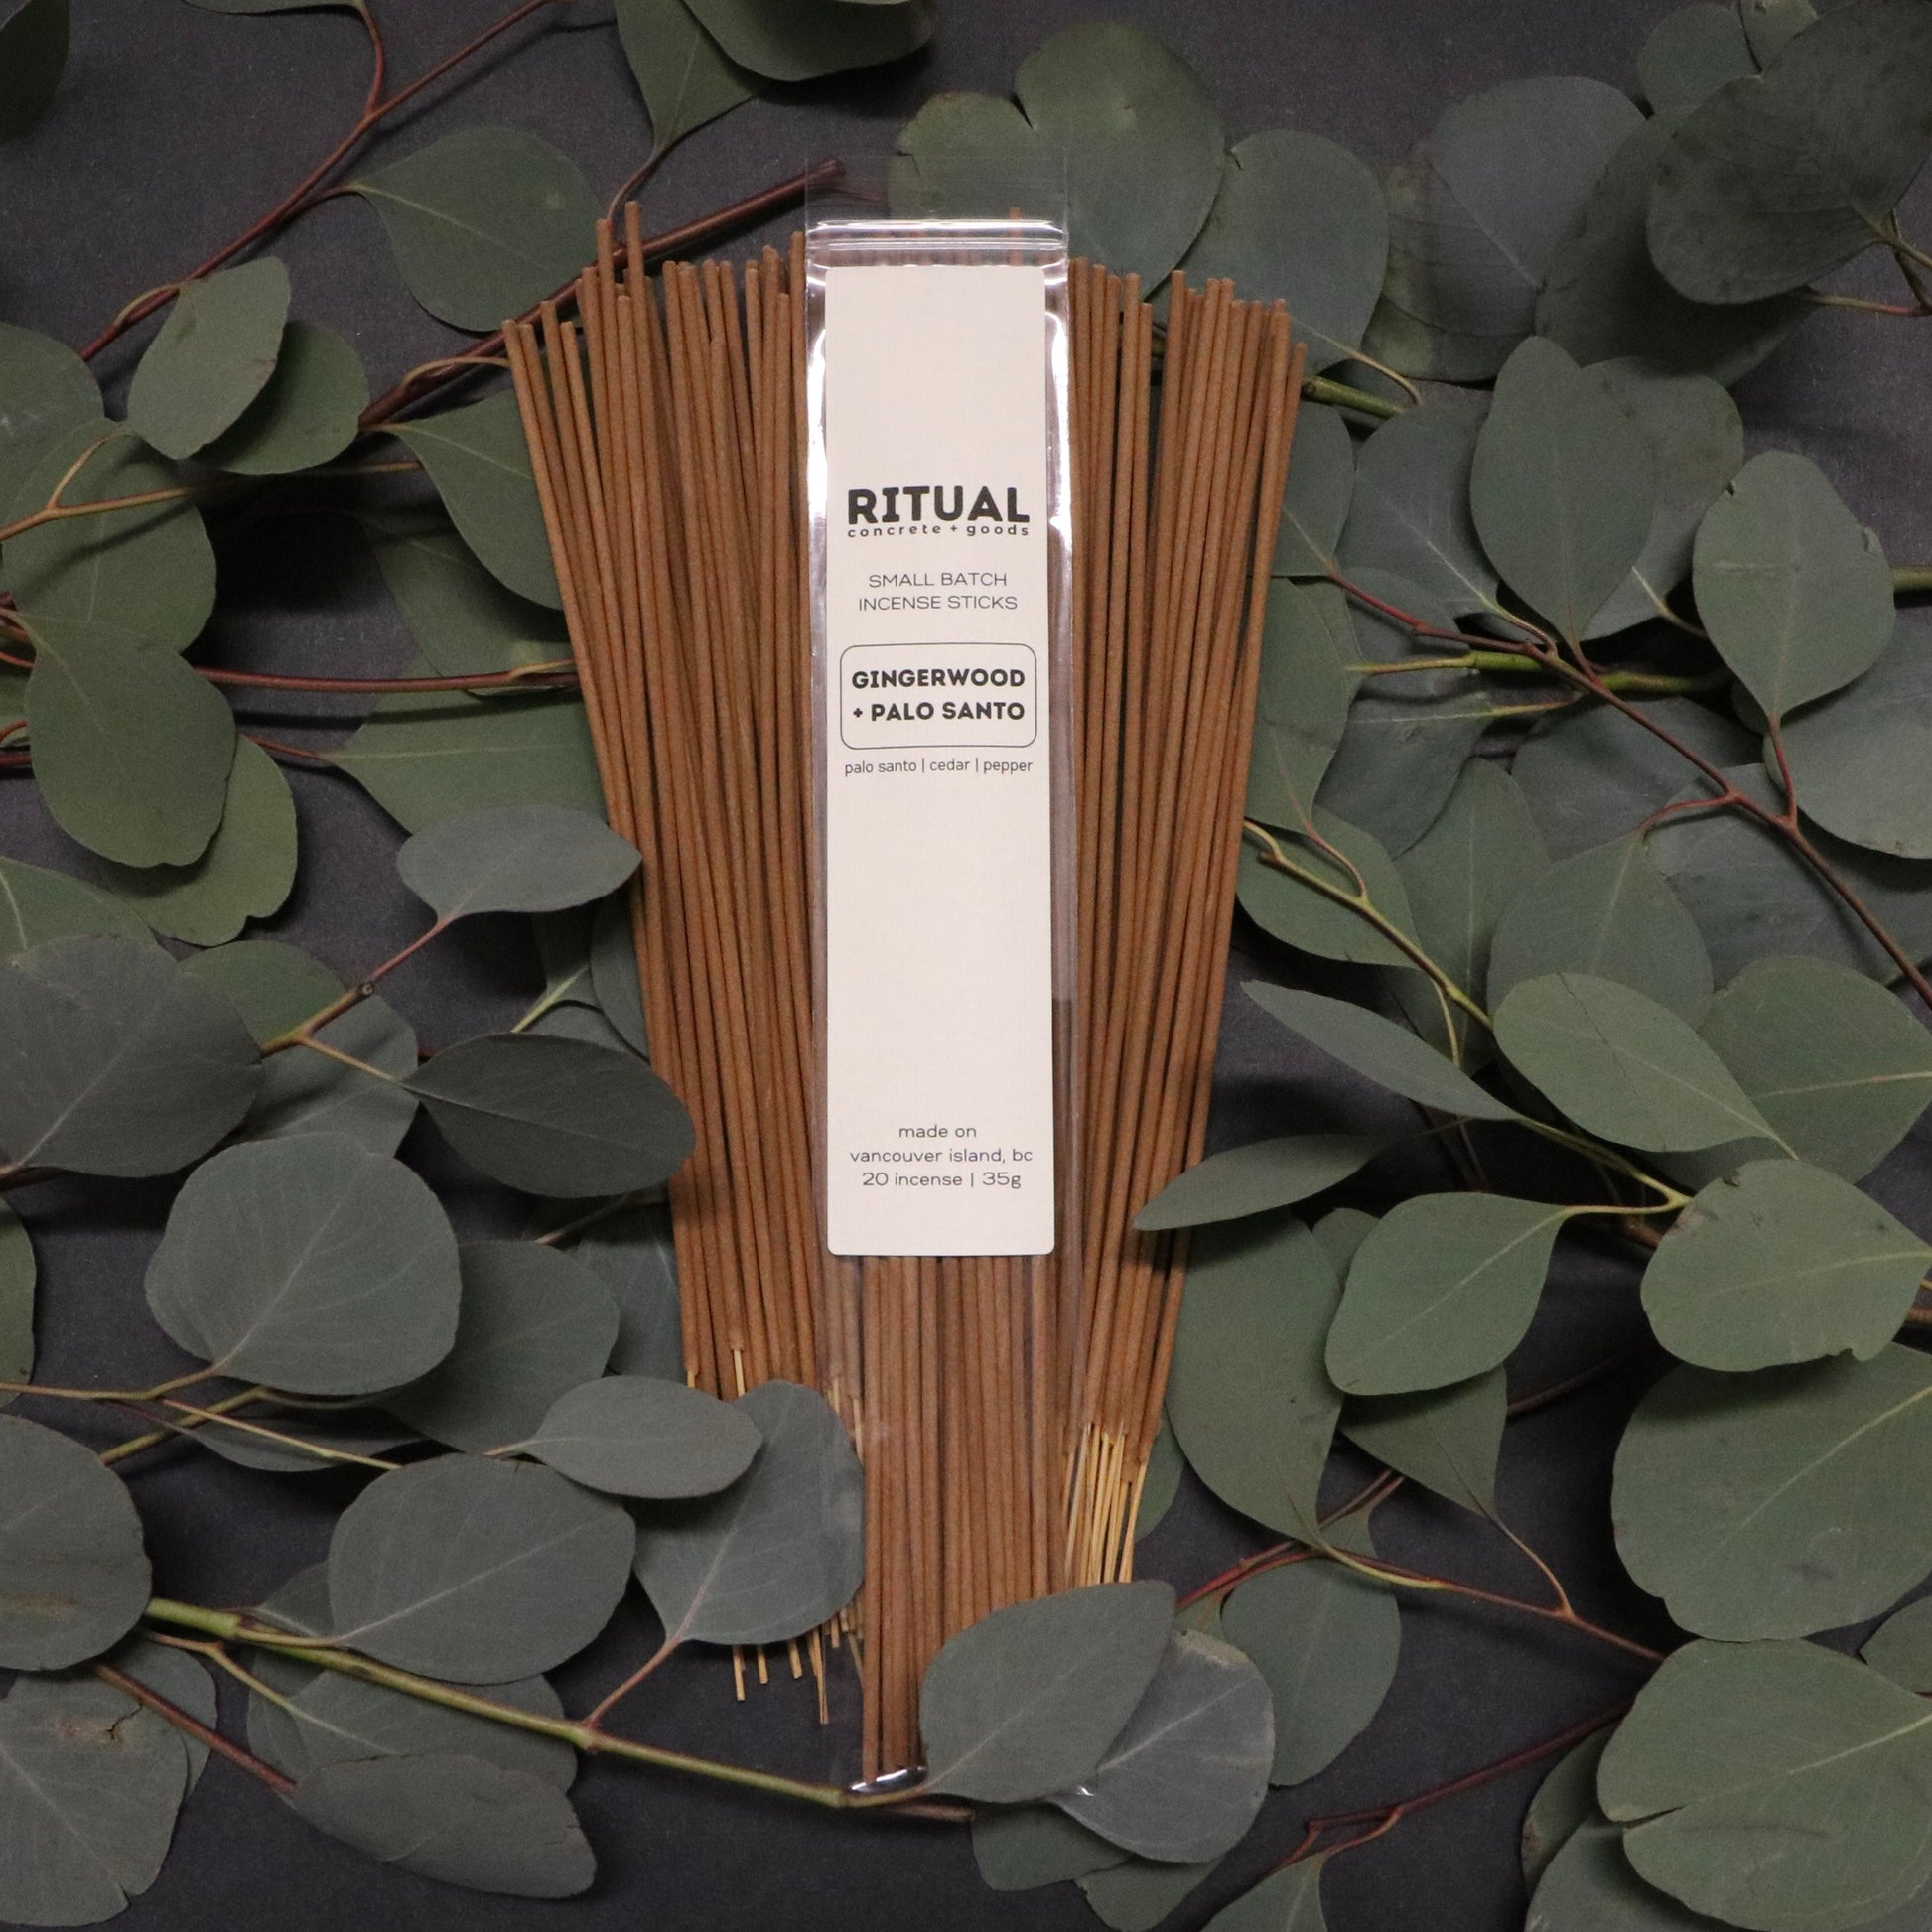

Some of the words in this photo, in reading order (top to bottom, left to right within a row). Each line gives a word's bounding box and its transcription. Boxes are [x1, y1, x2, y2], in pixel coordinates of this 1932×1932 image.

[847, 484, 1031, 526] RITUAL
[847, 523, 942, 538] concrete
[949, 524, 958, 533] +
[965, 523, 1029, 537] goods
[868, 573, 935, 588] SMALL
[940, 572, 1007, 586] BATCH
[859, 596, 941, 611] INCENSE
[947, 596, 1018, 610] STICKS
[851, 667, 1026, 690] GINGERWOOD
[852, 707, 864, 719] +
[870, 701, 935, 723] PALO
[941, 701, 1026, 721] SANTO
[844, 759, 874, 777] palo
[878, 759, 917, 773] santo
[929, 758, 971, 772] cedar
[983, 760, 1034, 775] pepper
[898, 1124, 949, 1139] made
[954, 1127, 977, 1138] on
[849, 1152, 943, 1163] vancouver
[948, 1148, 1006, 1165] island,
[1012, 1148, 1034, 1162] bc
[862, 1172, 889, 1187] 20
[895, 1172, 963, 1187] incense
[982, 1171, 1022, 1190] 35g
